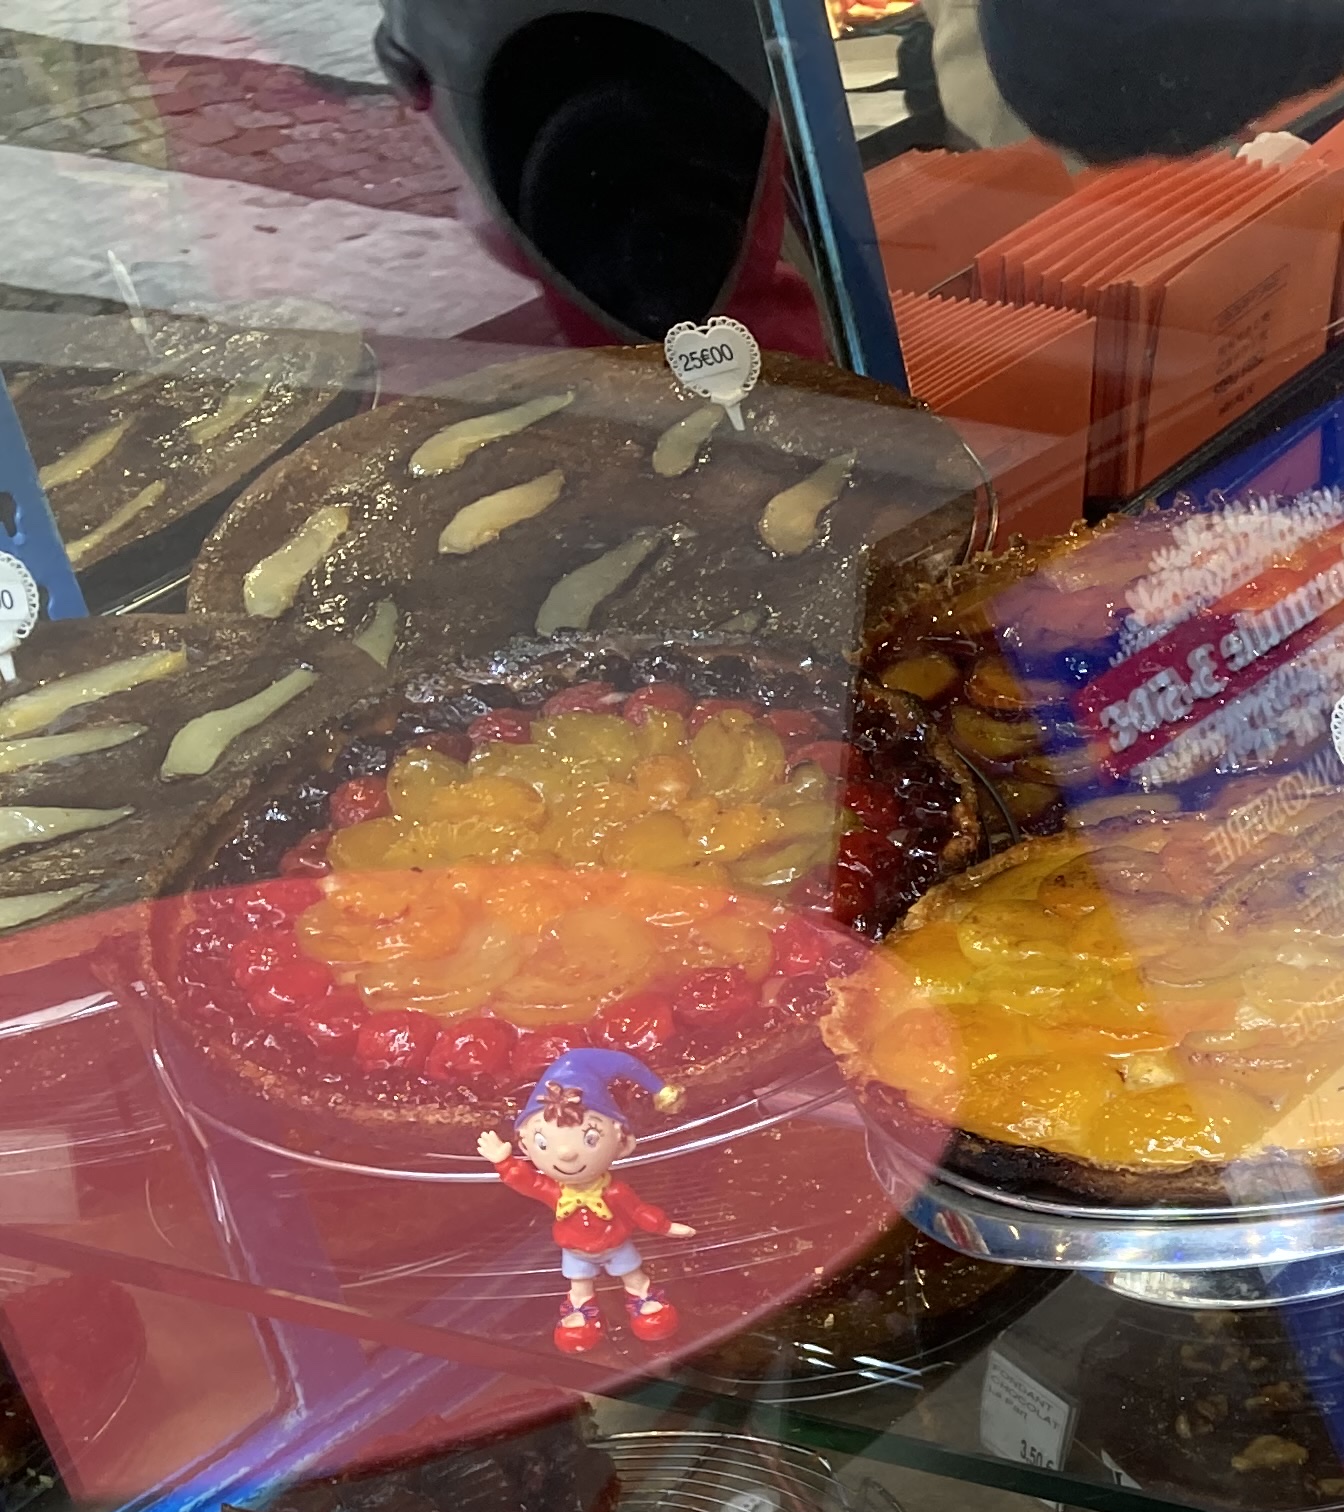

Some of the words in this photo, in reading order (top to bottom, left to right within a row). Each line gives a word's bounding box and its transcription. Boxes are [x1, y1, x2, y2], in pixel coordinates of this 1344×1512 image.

[678, 343, 734, 373] 25€00
[990, 1374, 1060, 1431] CHOCOLAT
[991, 1363, 1054, 1412] FONDANT
